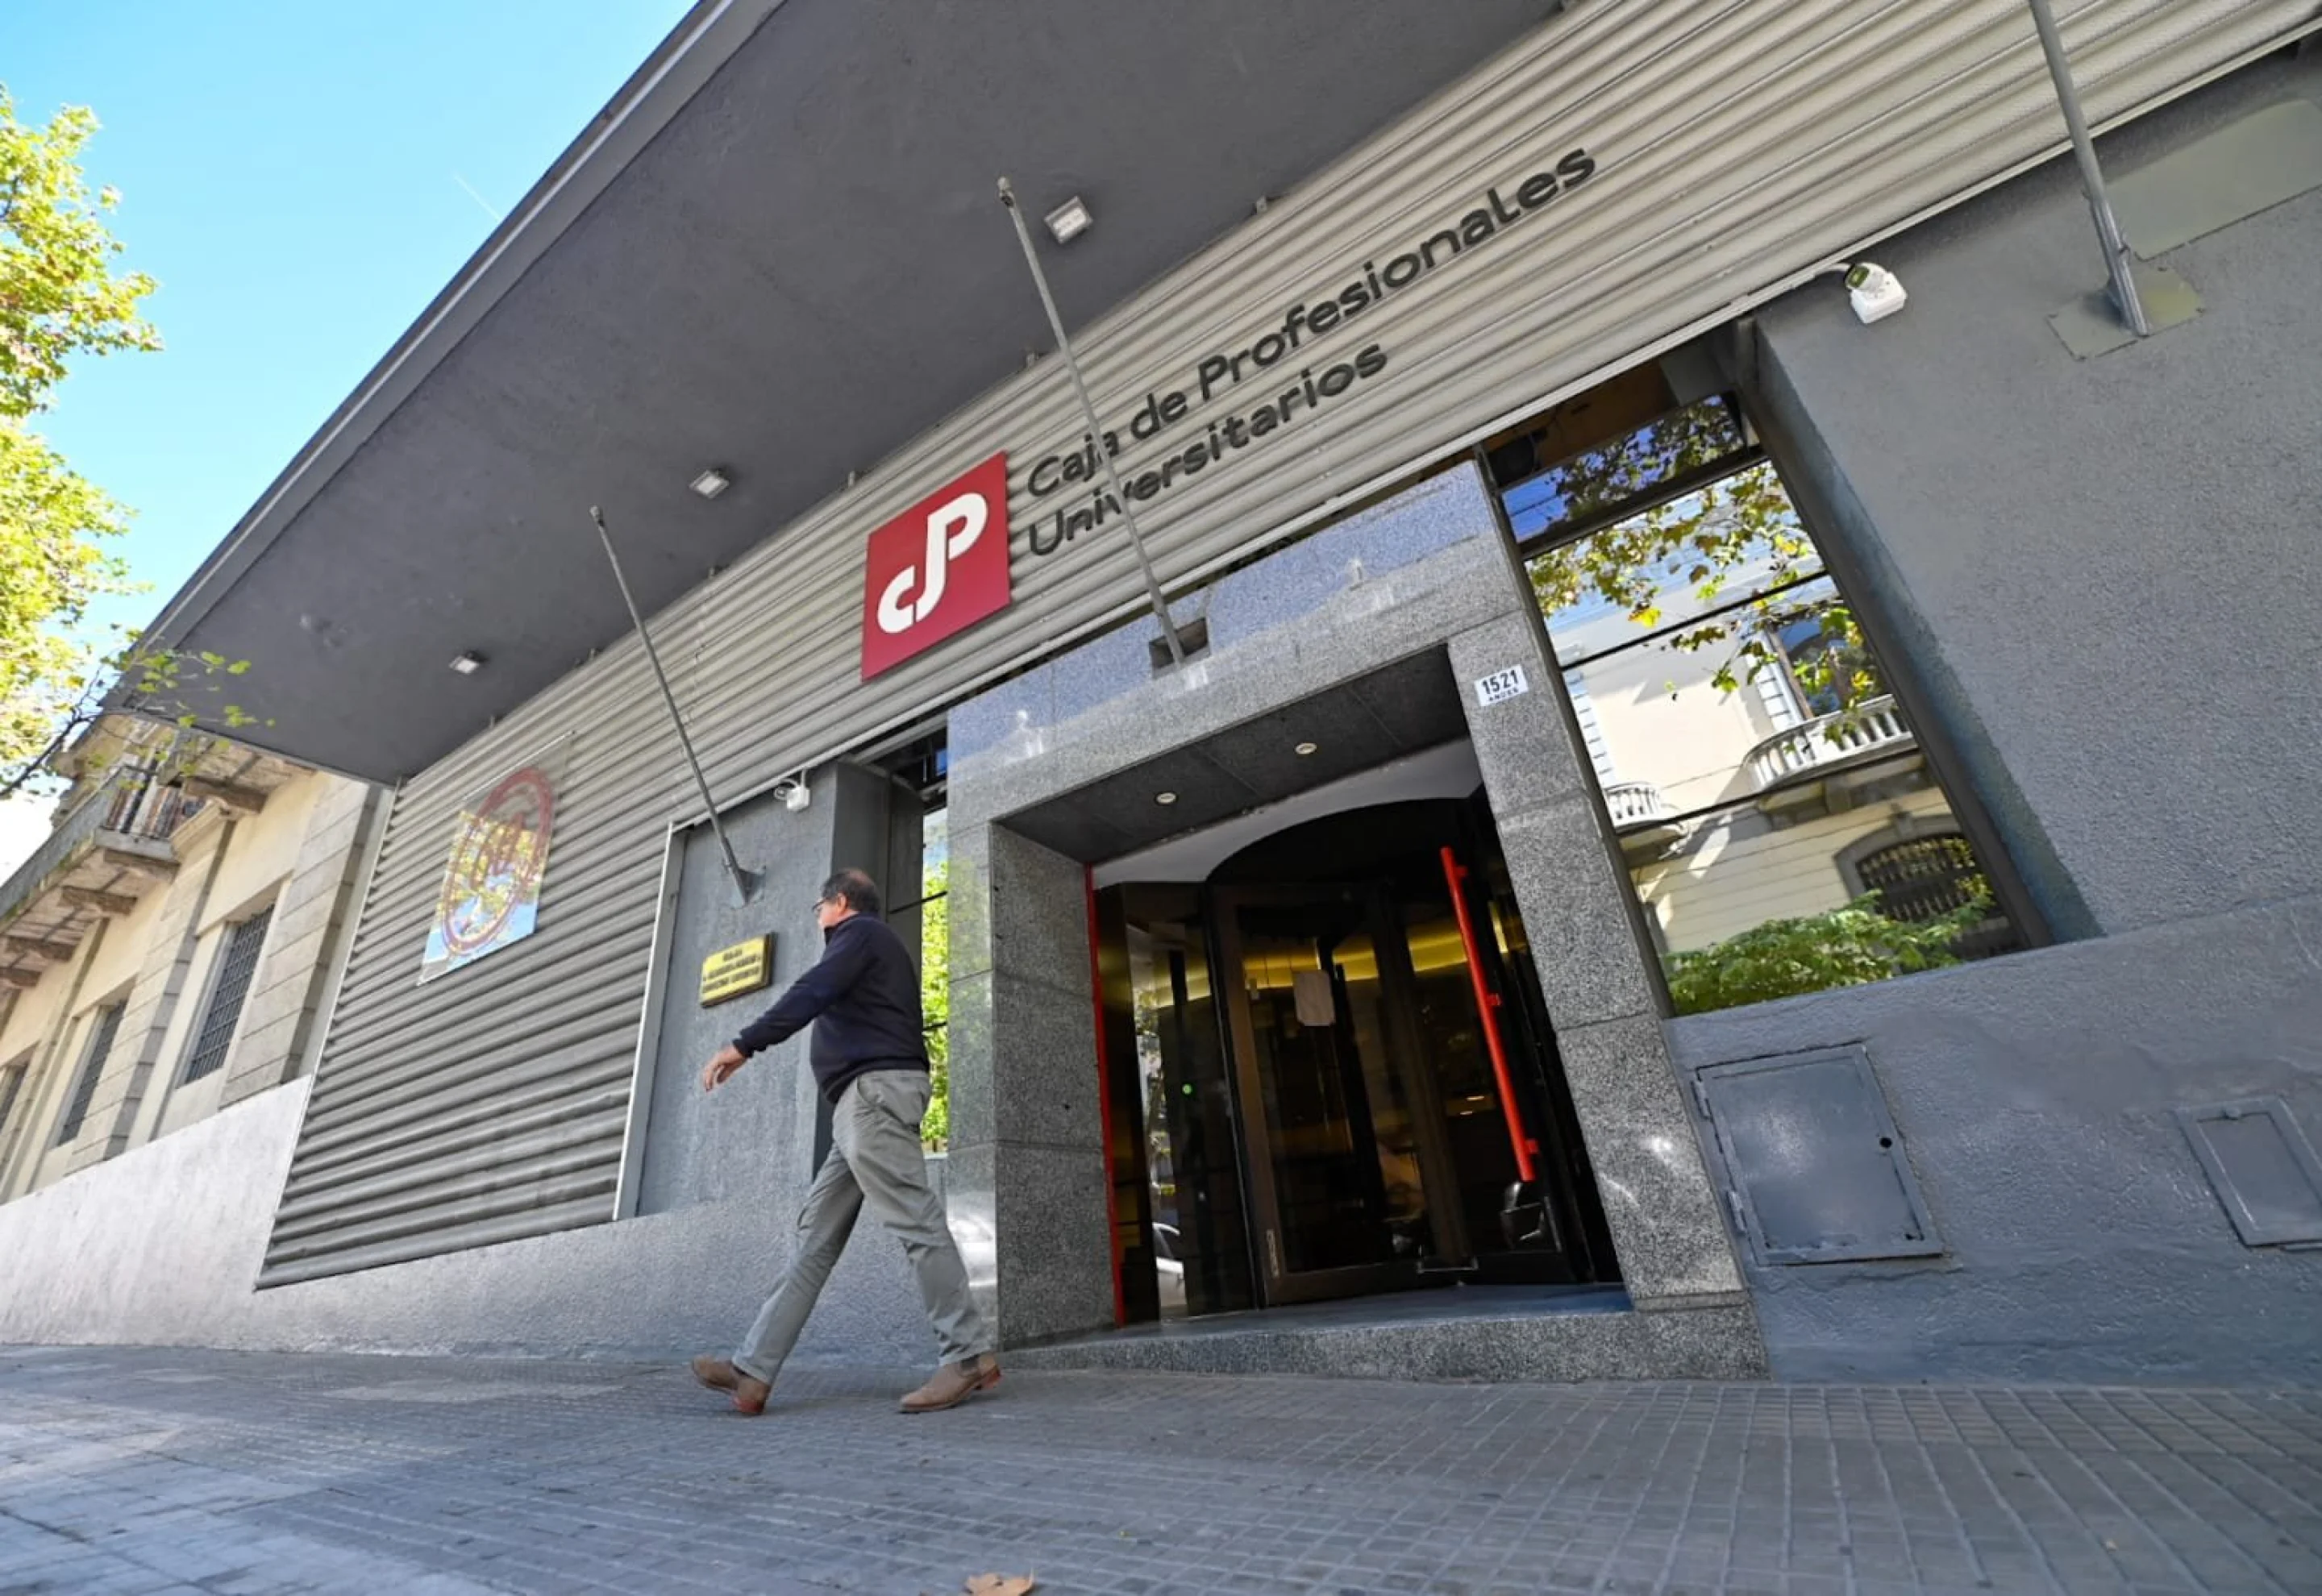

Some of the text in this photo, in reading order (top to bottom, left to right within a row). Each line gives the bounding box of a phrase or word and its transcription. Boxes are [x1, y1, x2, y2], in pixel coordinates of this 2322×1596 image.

[1028, 148, 1596, 497] Caja de Profesionales
[1029, 343, 1388, 555] Universitarios
[1482, 669, 1518, 695] 1521
